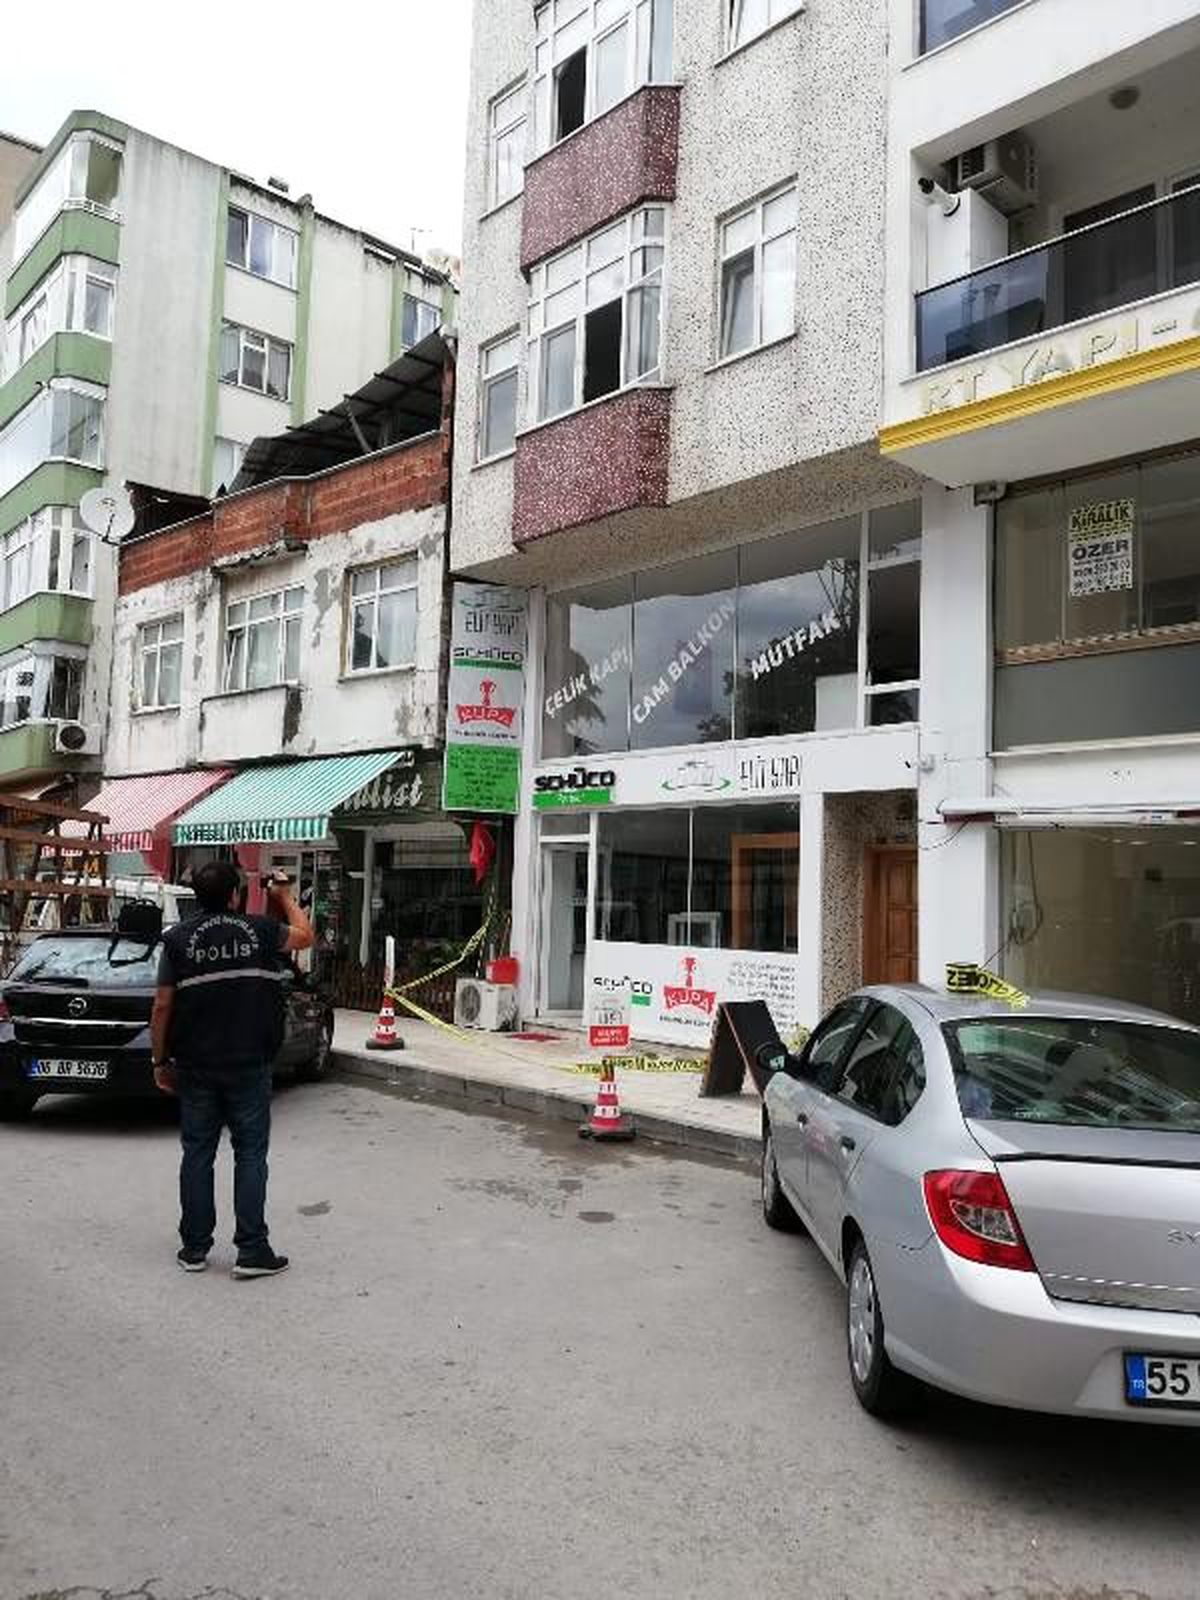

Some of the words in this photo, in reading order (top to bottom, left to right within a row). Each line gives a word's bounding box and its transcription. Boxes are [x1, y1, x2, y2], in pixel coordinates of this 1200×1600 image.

[1072, 540, 1129, 561] ÖZER
[632, 676, 670, 724] CAM
[667, 596, 737, 682] BALKON
[751, 608, 841, 680] MUTFAK
[545, 671, 588, 719] ÇELİK
[534, 767, 616, 791] SCHÜCO
[195, 938, 252, 963] POLİS
[1147, 1361, 1191, 1396] 55
